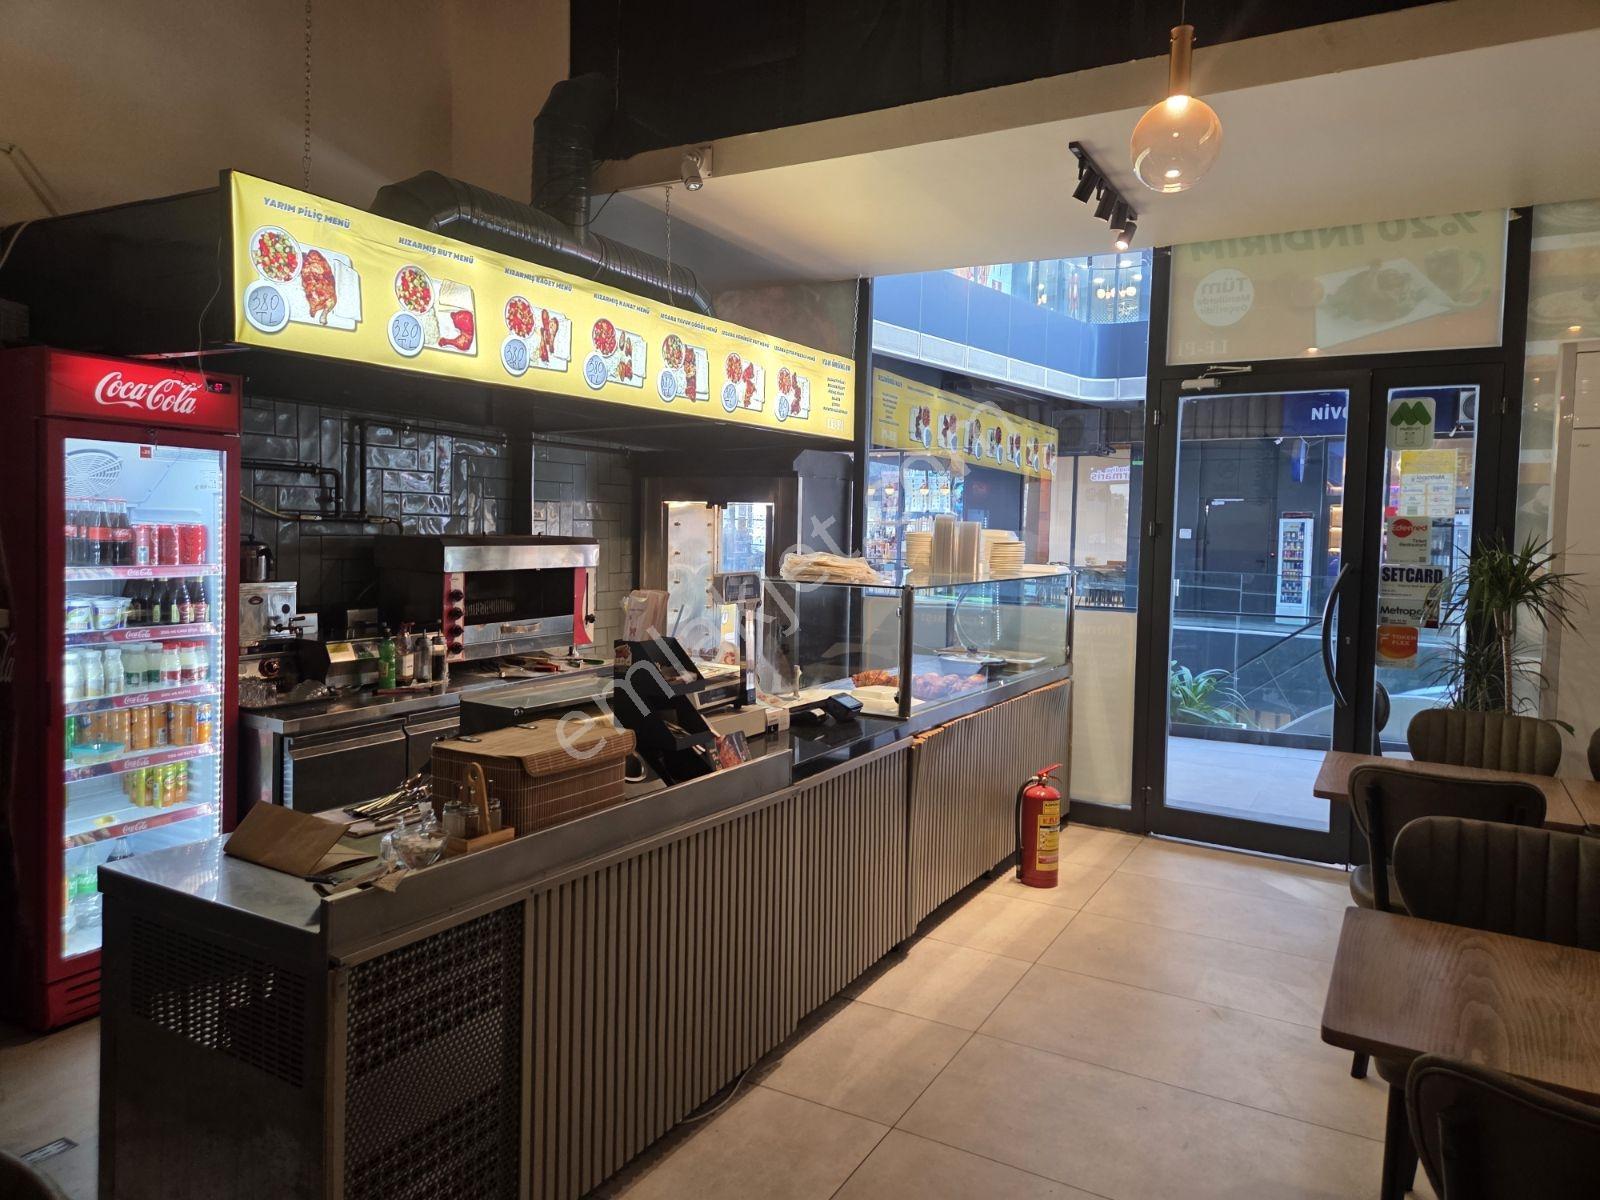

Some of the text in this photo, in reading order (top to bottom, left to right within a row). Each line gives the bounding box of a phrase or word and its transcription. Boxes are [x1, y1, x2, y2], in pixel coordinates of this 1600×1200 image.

[263, 196, 350, 229] YARIM PİLİÇ MENÜ
[399, 237, 474, 264] KIZARMIŞ BUT MENÜ
[250, 291, 280, 310] 380
[392, 320, 420, 338] 380
[95, 371, 202, 414] Coca-Cola
[1382, 566, 1443, 584] SETCARD
